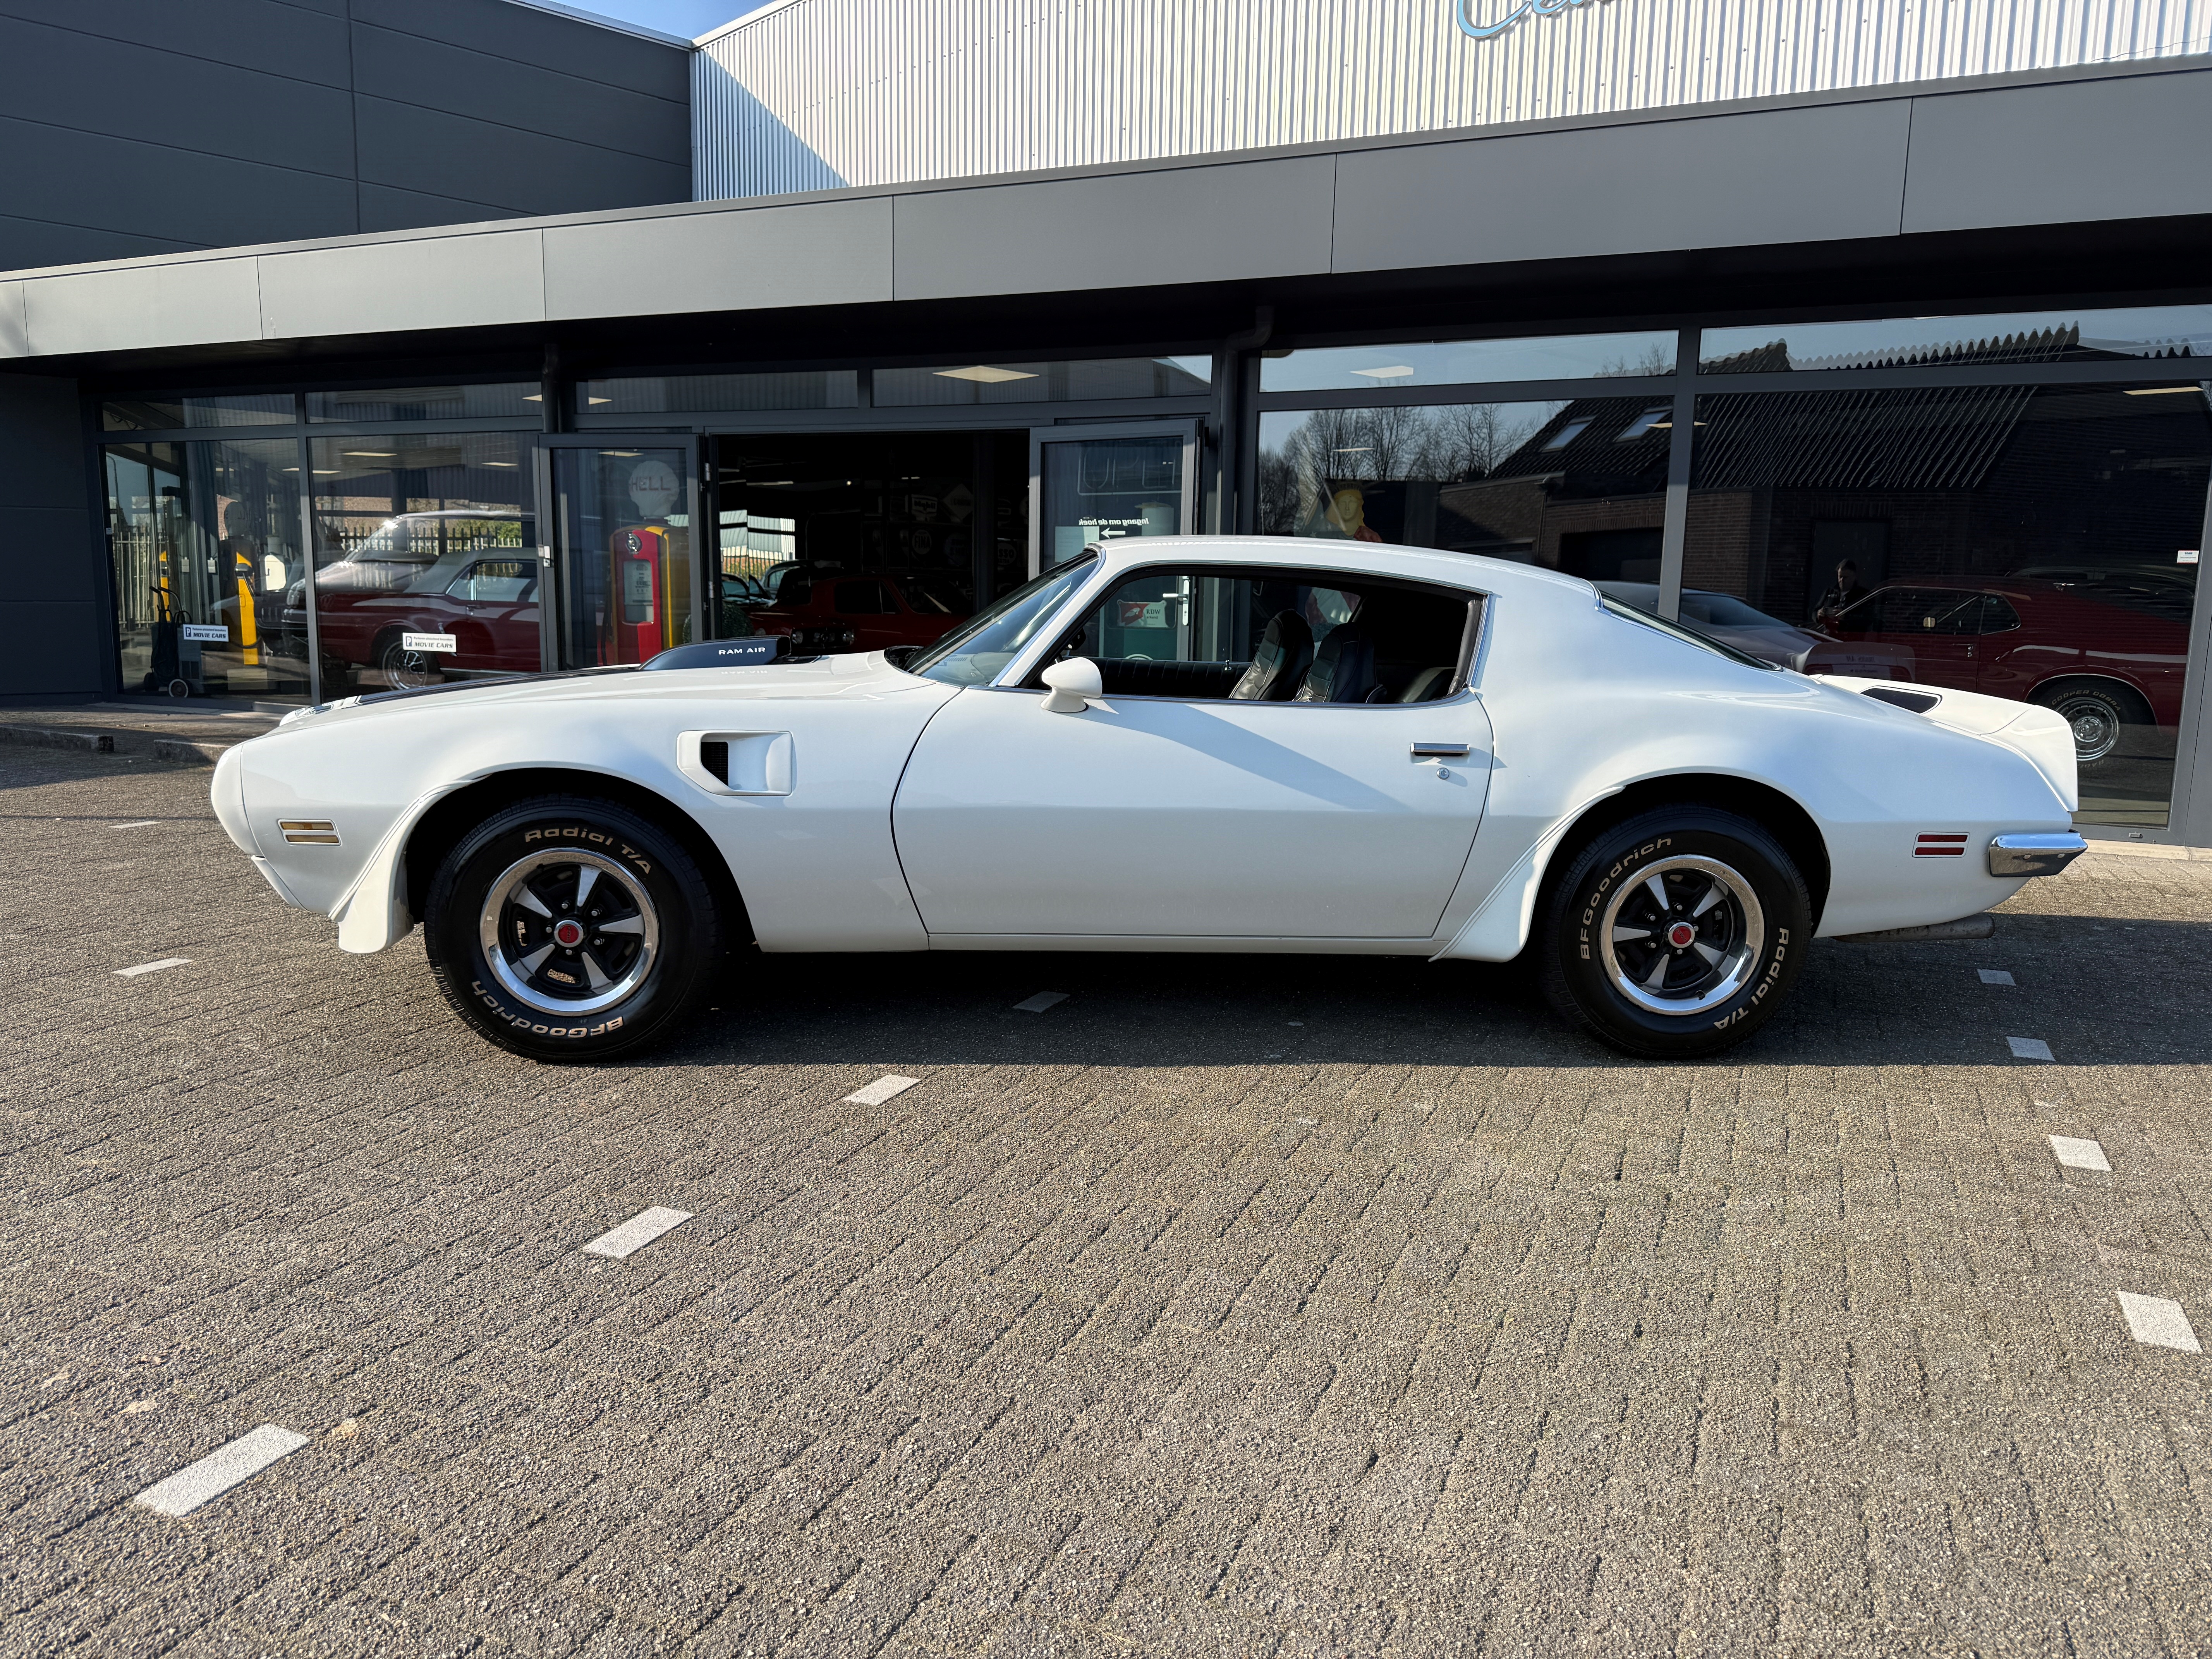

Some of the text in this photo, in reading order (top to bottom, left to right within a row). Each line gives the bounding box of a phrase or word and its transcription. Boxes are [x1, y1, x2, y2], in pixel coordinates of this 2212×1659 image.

[915, 536, 931, 548] FINA
[998, 549, 1014, 558] SSO
[2051, 690, 2121, 711] COOPER COBRA
[525, 827, 651, 874] Radial T/A
[1580, 838, 1671, 959] BFGoodrich
[1713, 927, 1789, 1030] Radial T/A
[472, 981, 624, 1039] BFGoodrich
